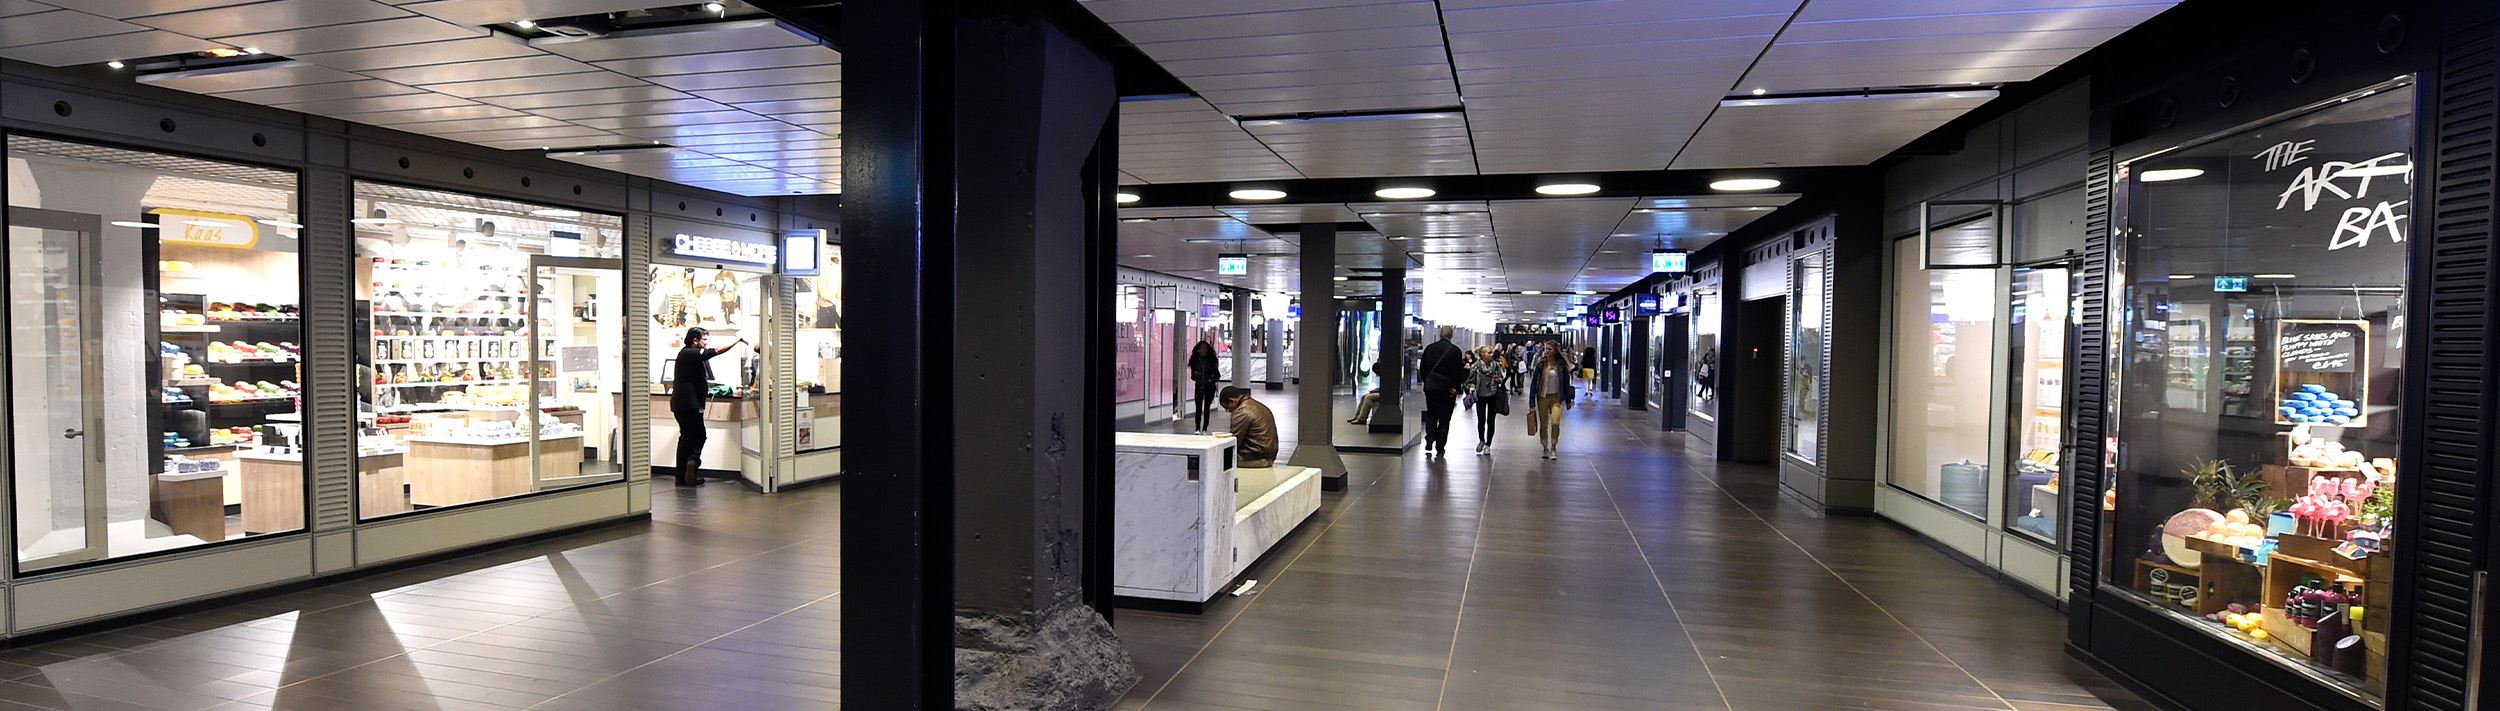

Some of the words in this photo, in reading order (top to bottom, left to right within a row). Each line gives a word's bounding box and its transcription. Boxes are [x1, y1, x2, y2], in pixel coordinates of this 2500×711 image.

[2252, 139, 2316, 172] THE
[2276, 152, 2405, 211] ART
[185, 218, 222, 242] Kaas
